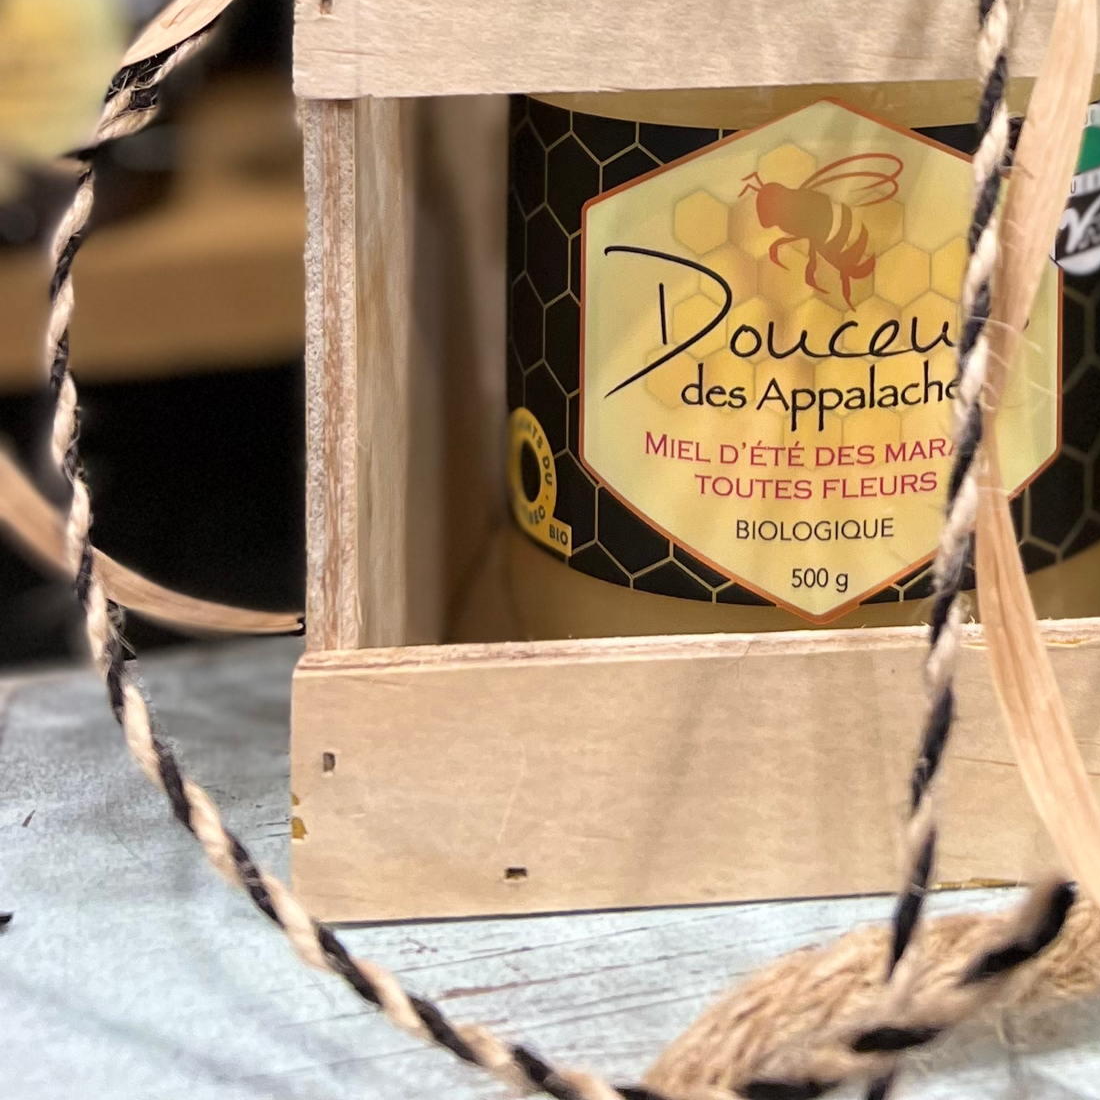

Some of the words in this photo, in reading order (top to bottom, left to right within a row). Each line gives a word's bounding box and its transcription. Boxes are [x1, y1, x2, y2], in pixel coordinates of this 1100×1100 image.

[604, 245, 957, 398] Douceu
[680, 364, 747, 409] des
[644, 430, 710, 463] MIEL
[719, 440, 806, 468] D'ÉTÉ
[814, 444, 876, 467] DES
[695, 473, 812, 500] TOUTES
[822, 471, 938, 500] FLEURS
[549, 523, 569, 547] BIO
[736, 517, 894, 542] BIOLOGIQUE
[791, 567, 829, 589] 500
[835, 573, 849, 593] g
